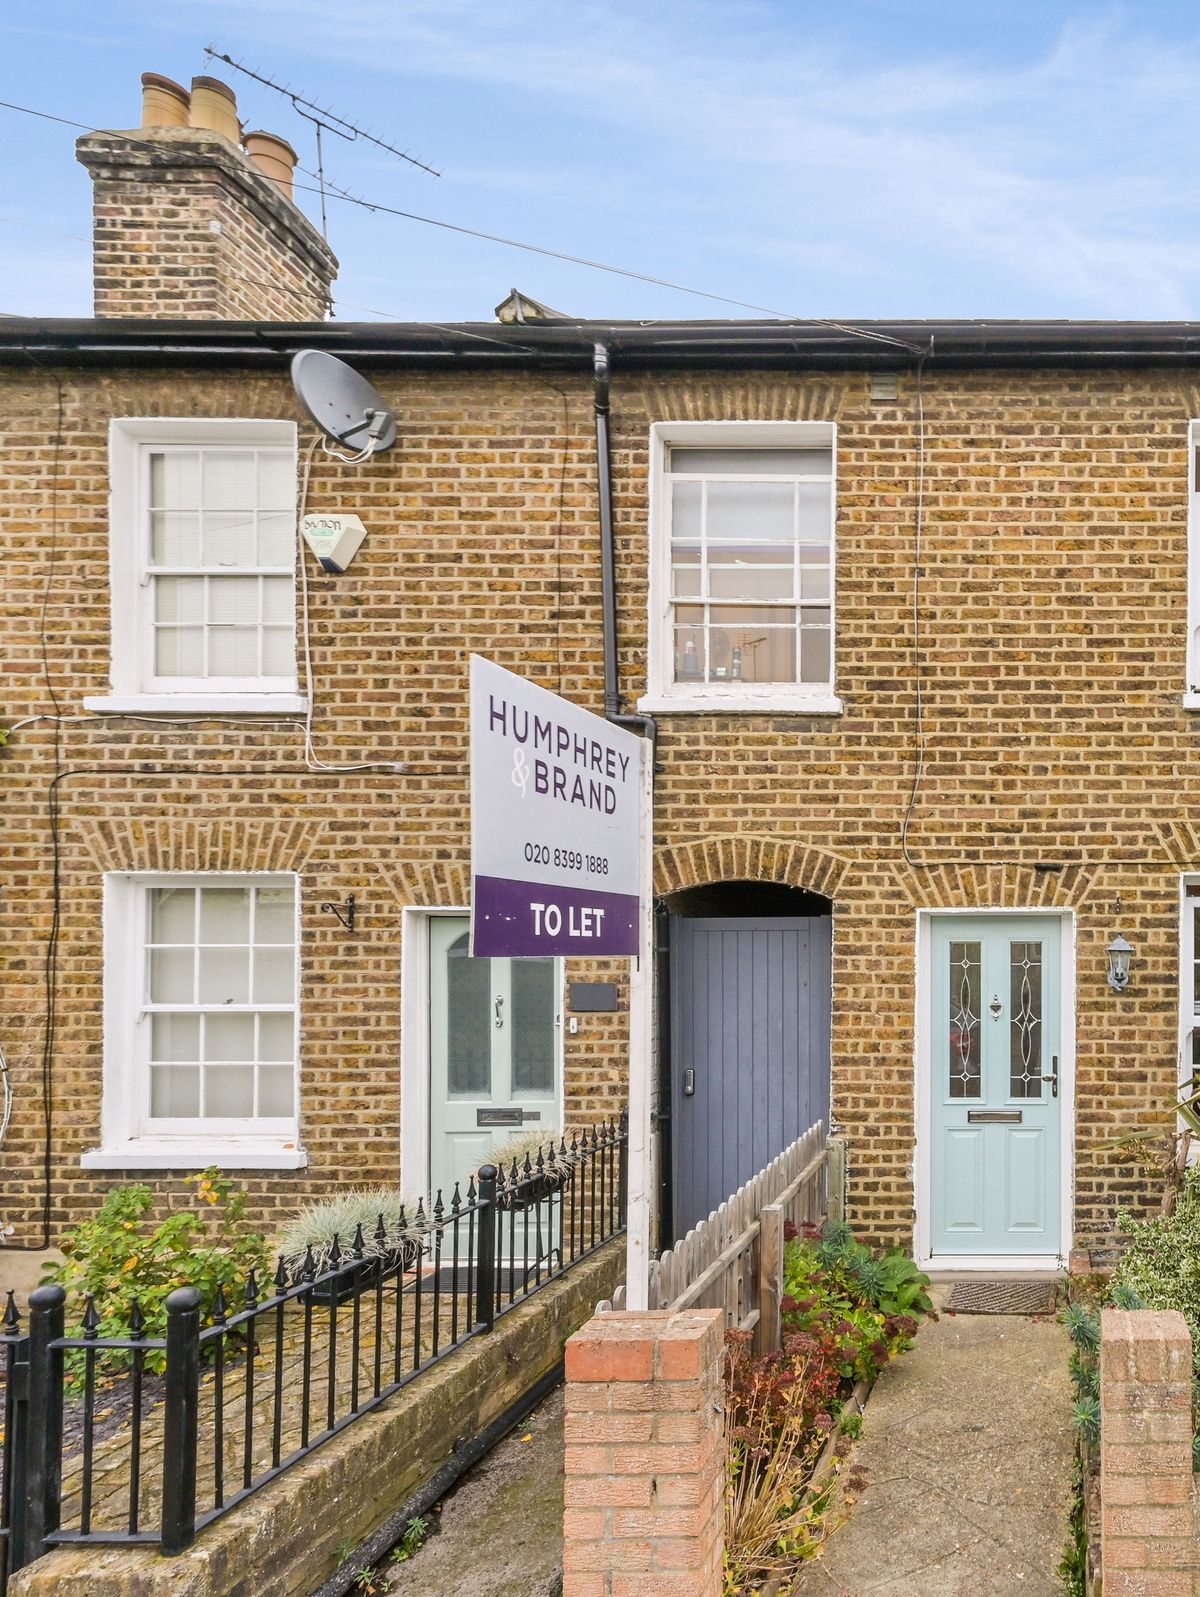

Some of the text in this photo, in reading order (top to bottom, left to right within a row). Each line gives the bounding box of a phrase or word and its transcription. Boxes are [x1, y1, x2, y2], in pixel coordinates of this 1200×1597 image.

[489, 694, 630, 783] HUMPHREY
[511, 747, 617, 815] & BRAND
[524, 842, 609, 876] 020 8399 1888
[529, 902, 605, 938] TO LET
